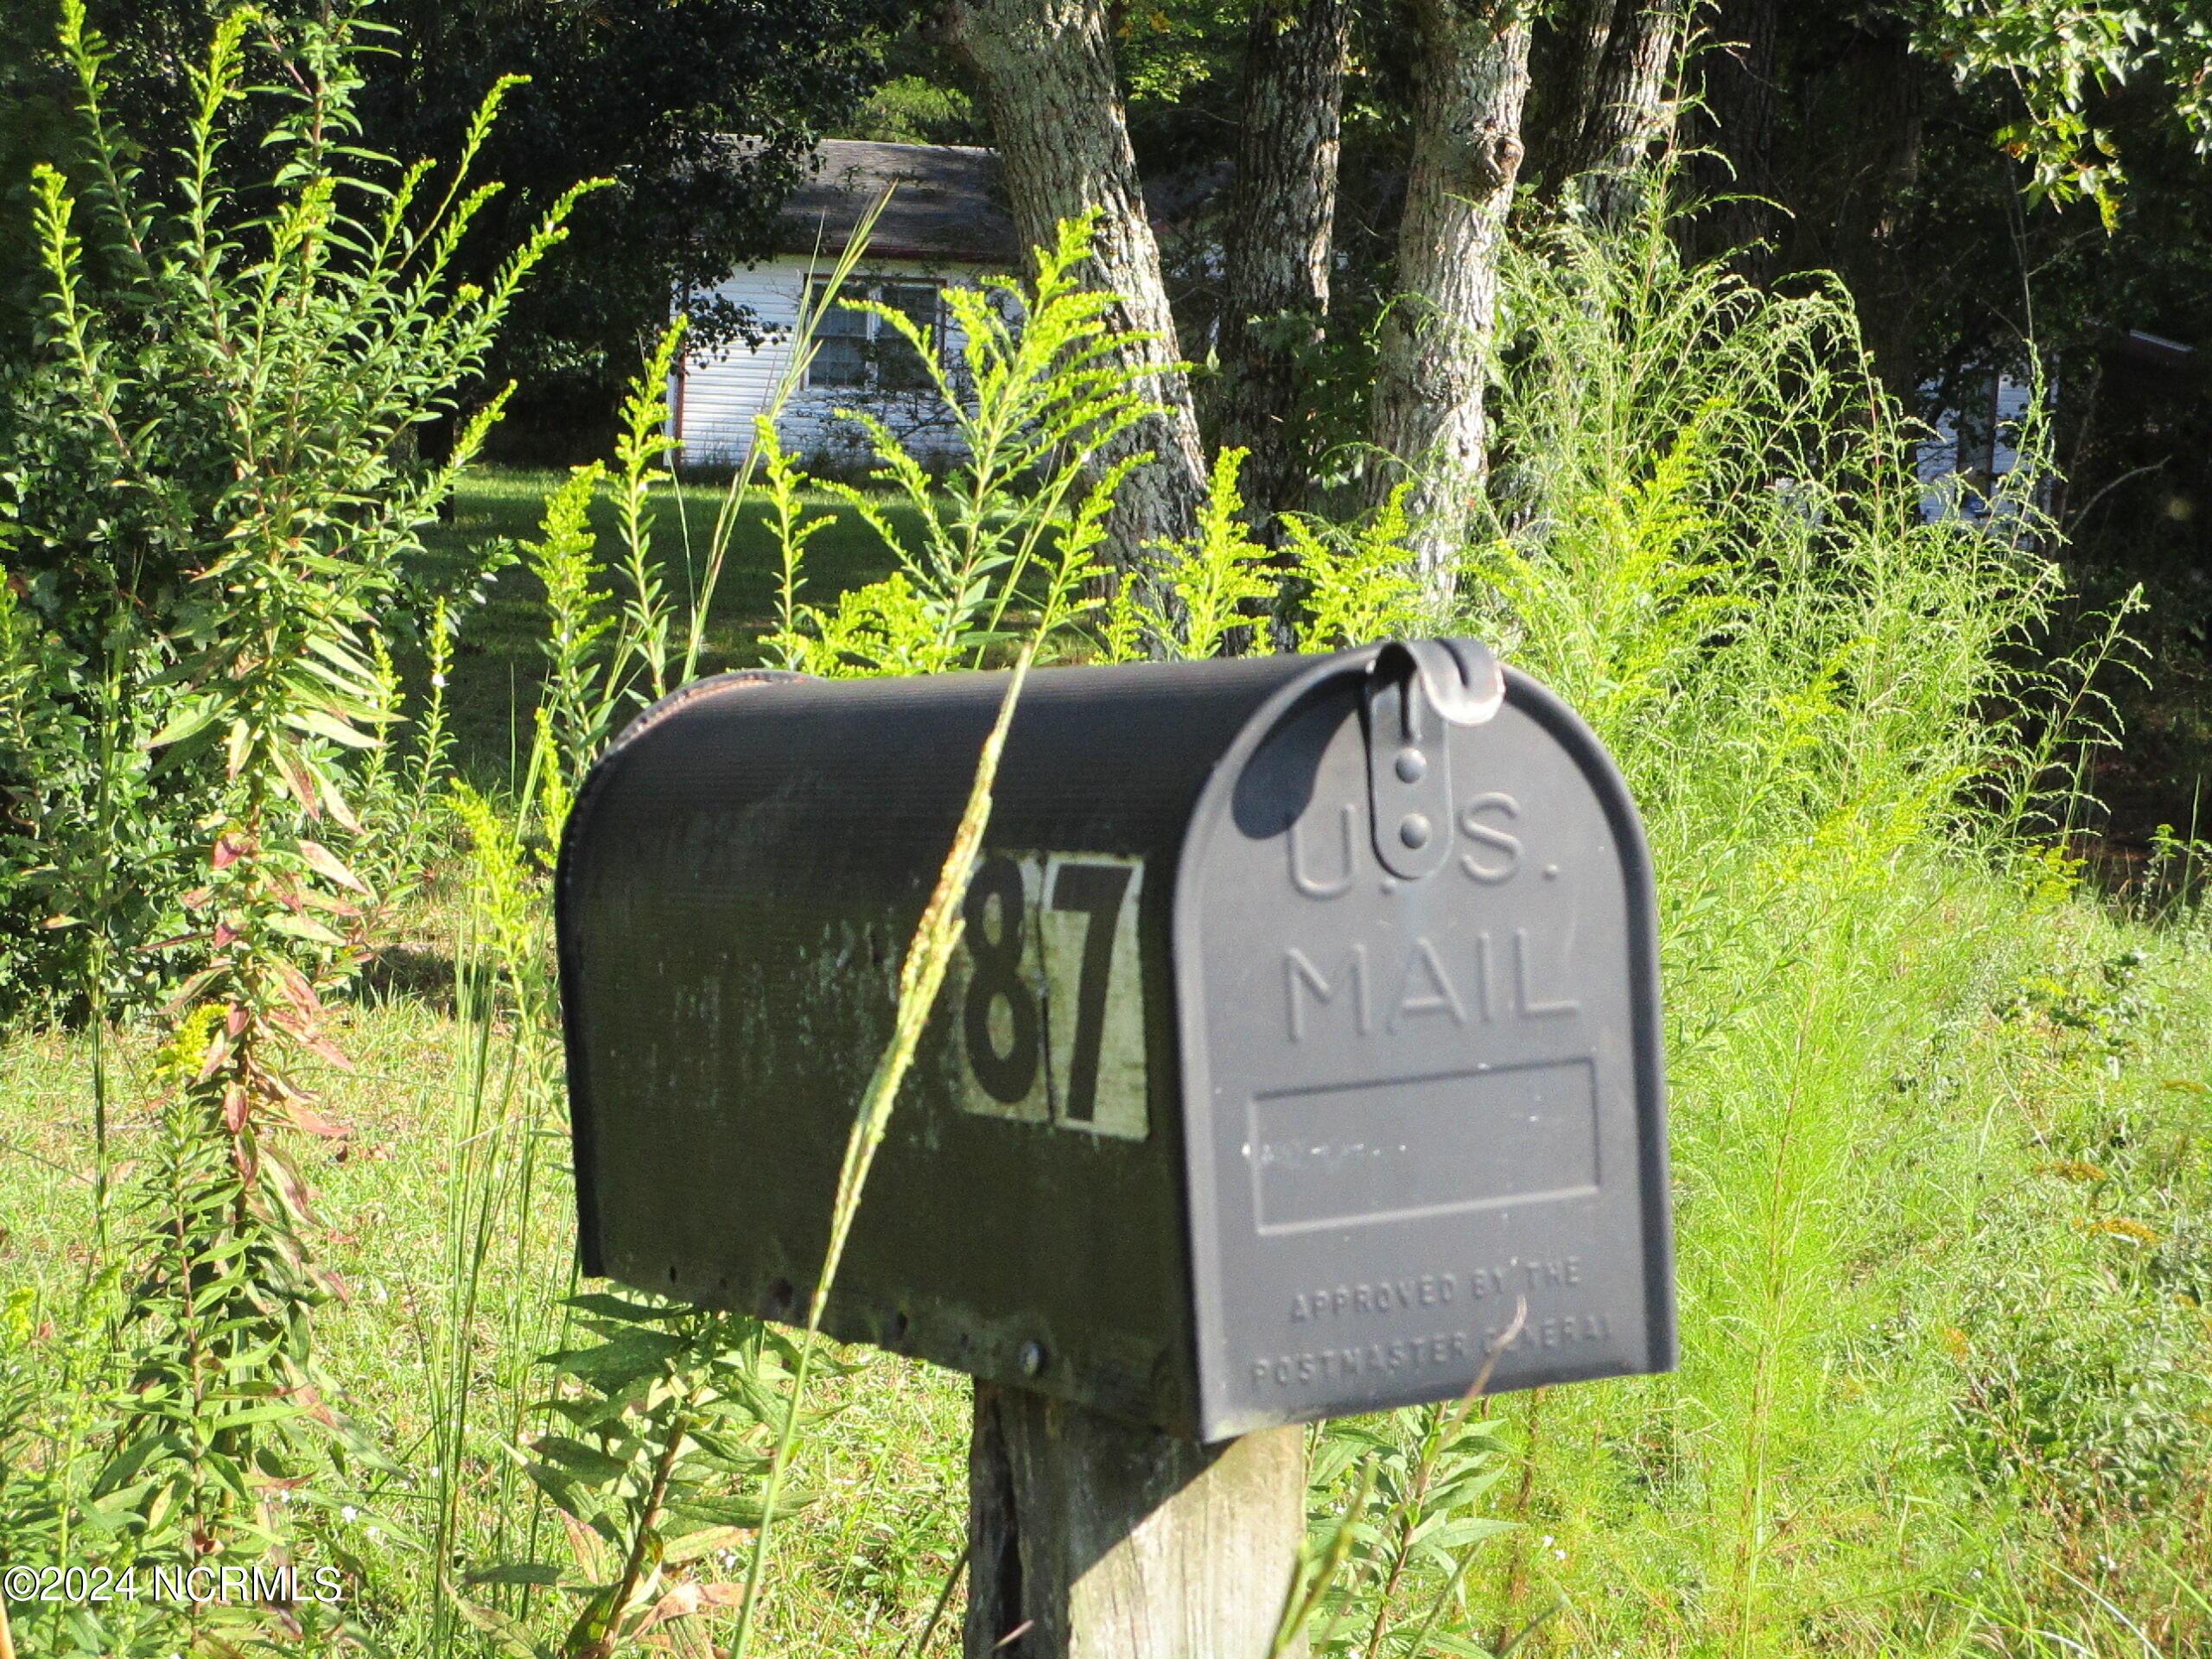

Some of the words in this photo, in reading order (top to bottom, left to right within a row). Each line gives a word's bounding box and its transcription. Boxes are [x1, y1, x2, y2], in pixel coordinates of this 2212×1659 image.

[1287, 791, 1559, 900] U.S.
[963, 854, 1134, 1122] 87
[1285, 927, 1582, 1043] MAIL
[1289, 1272, 1458, 1323] APPROVED
[1471, 1264, 1508, 1300] BY
[1523, 1255, 1582, 1292] THE
[1250, 1329, 1468, 1389] POSTMASTER
